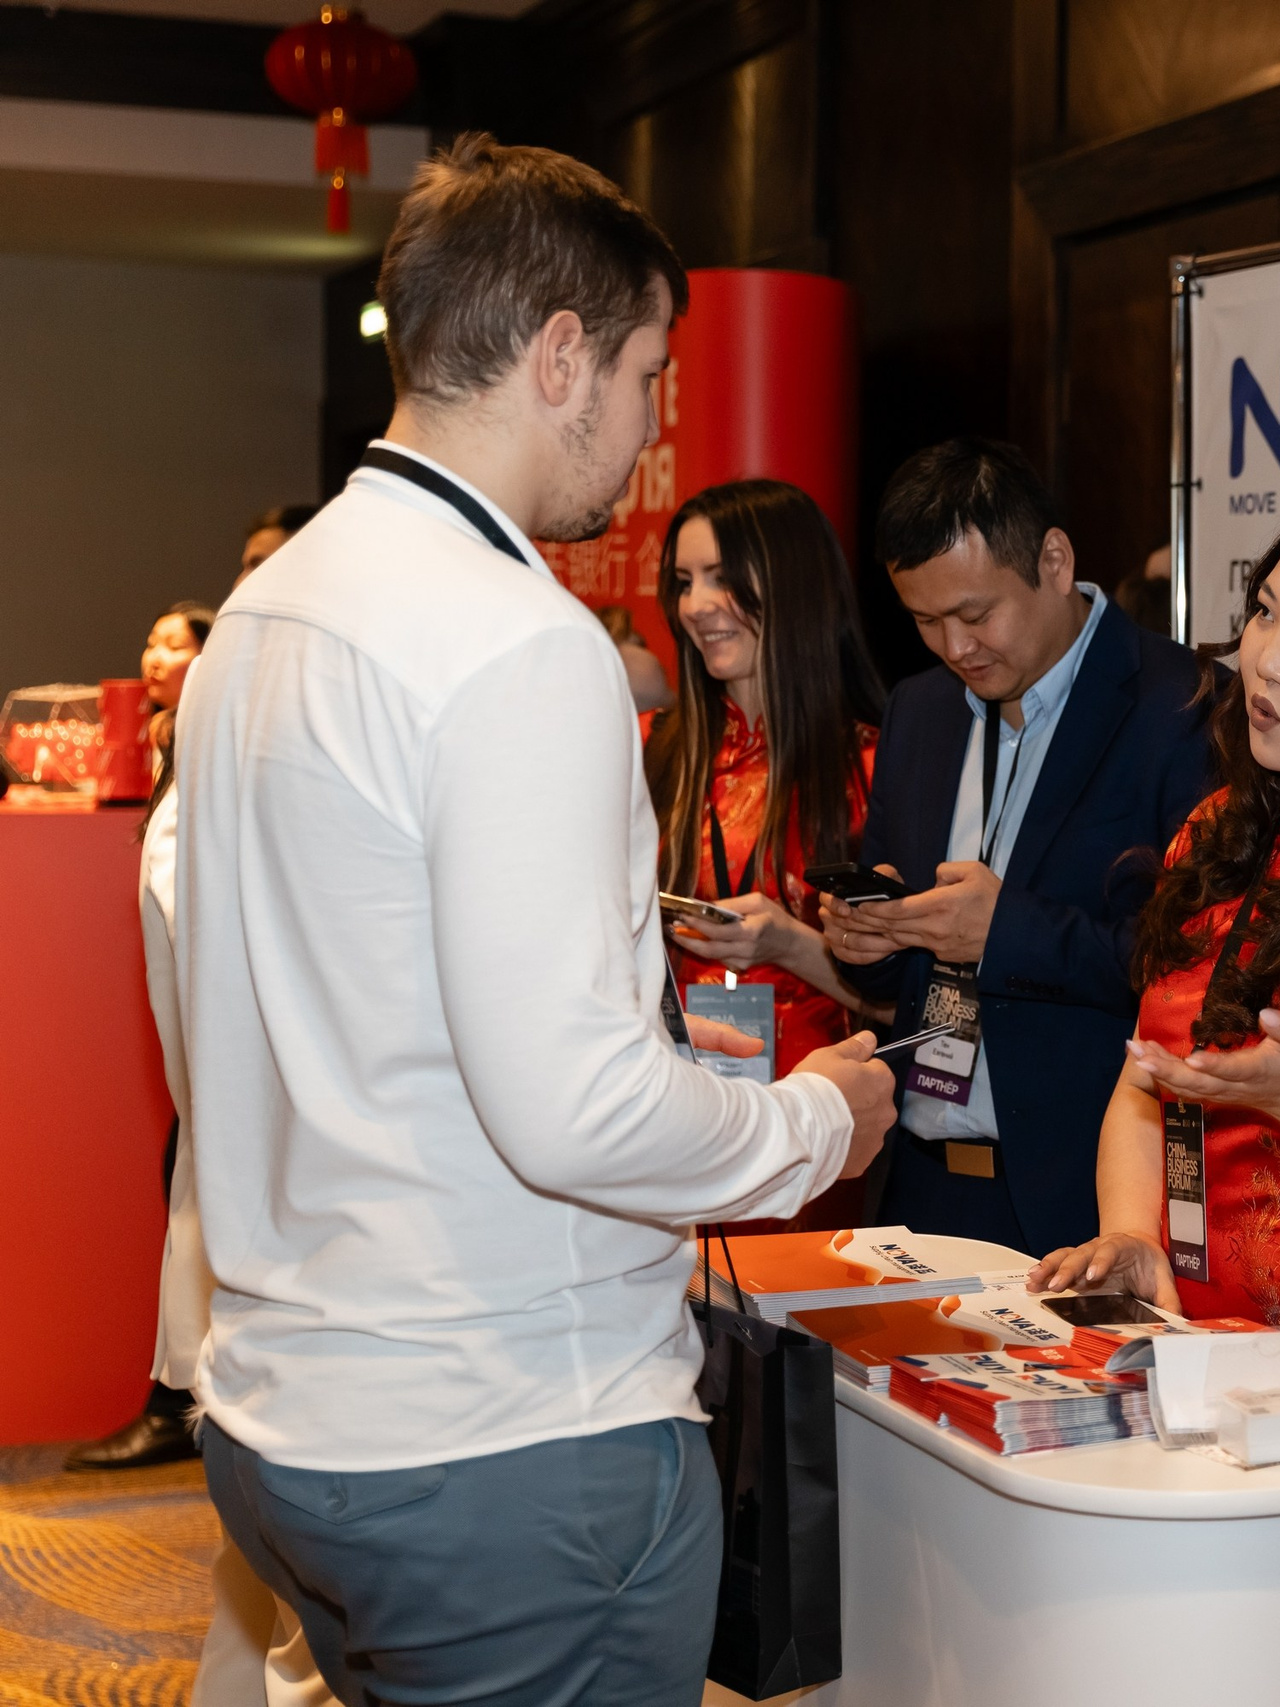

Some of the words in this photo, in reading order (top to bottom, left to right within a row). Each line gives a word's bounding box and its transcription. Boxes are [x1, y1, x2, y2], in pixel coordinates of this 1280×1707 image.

[1229, 491, 1277, 516] MOVE
[928, 984, 961, 1003] CHINA
[925, 996, 977, 1021] BUSINESS
[922, 1009, 962, 1031] FORUM
[917, 1074, 960, 1096] ПАРТНЁР
[1167, 1141, 1188, 1160] CHINA
[1167, 1157, 1199, 1177] BUSINESS
[1167, 1173, 1192, 1191] FORUM
[879, 1244, 919, 1265] NOVA
[1175, 1253, 1201, 1271] ПАРТНЁР
[990, 1308, 1036, 1330] NOVA
